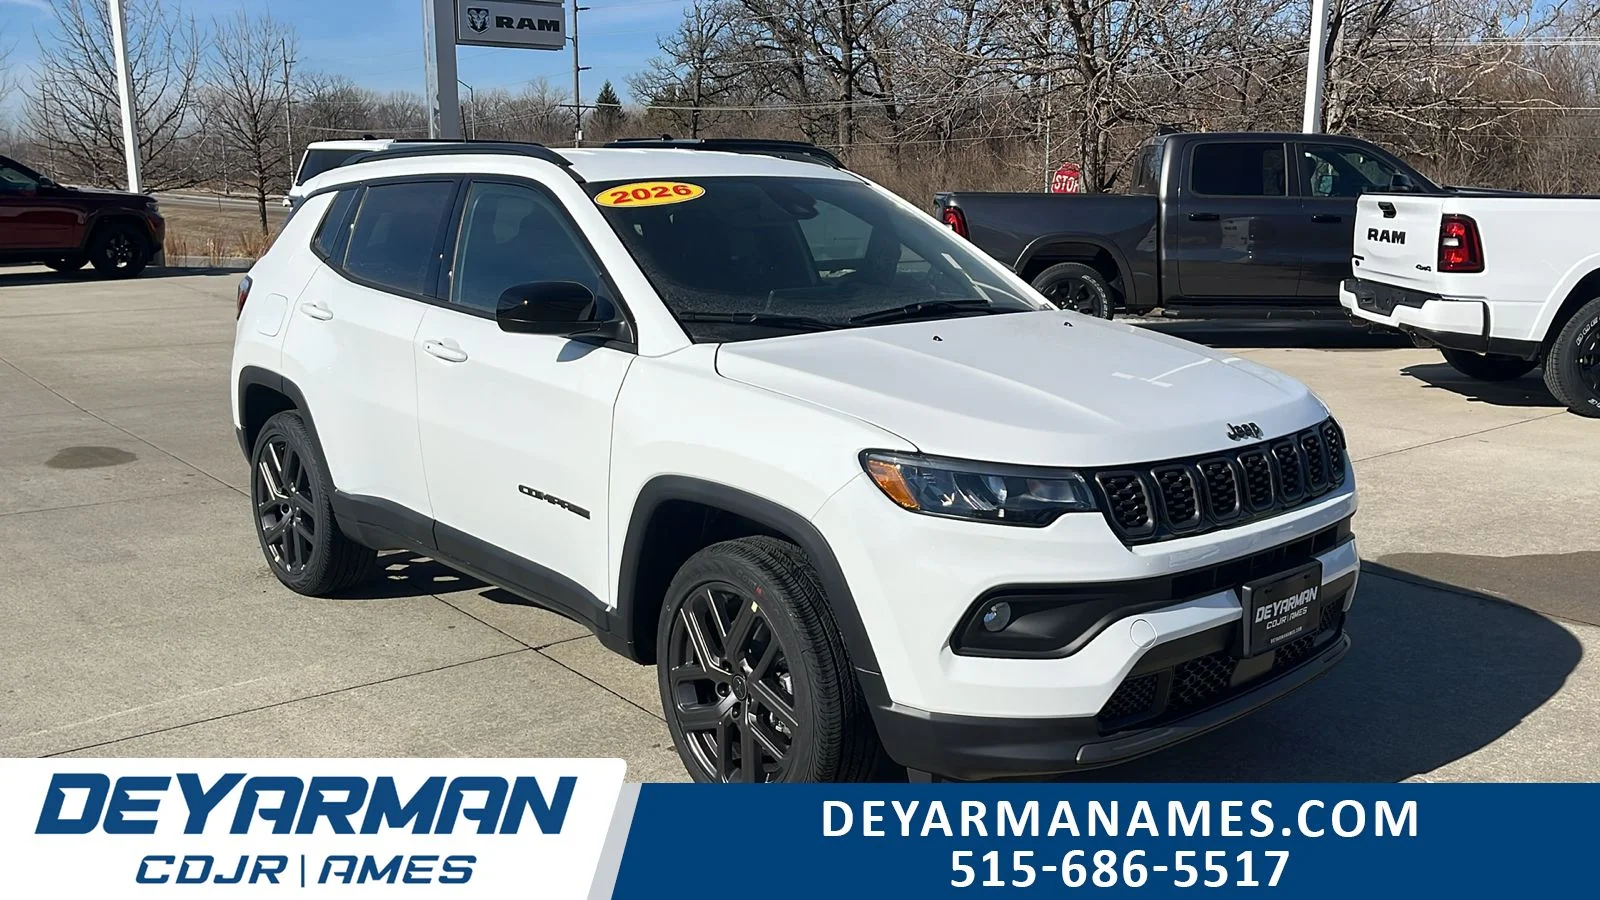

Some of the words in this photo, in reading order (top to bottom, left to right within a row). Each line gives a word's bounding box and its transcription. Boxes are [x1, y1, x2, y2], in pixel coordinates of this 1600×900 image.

[495, 15, 560, 32] RAM
[610, 185, 692, 204] 2026
[1367, 228, 1406, 245] RAM
[1226, 422, 1264, 441] Jeep
[1254, 586, 1318, 623] DEYARMAN
[1289, 606, 1308, 621] AMES
